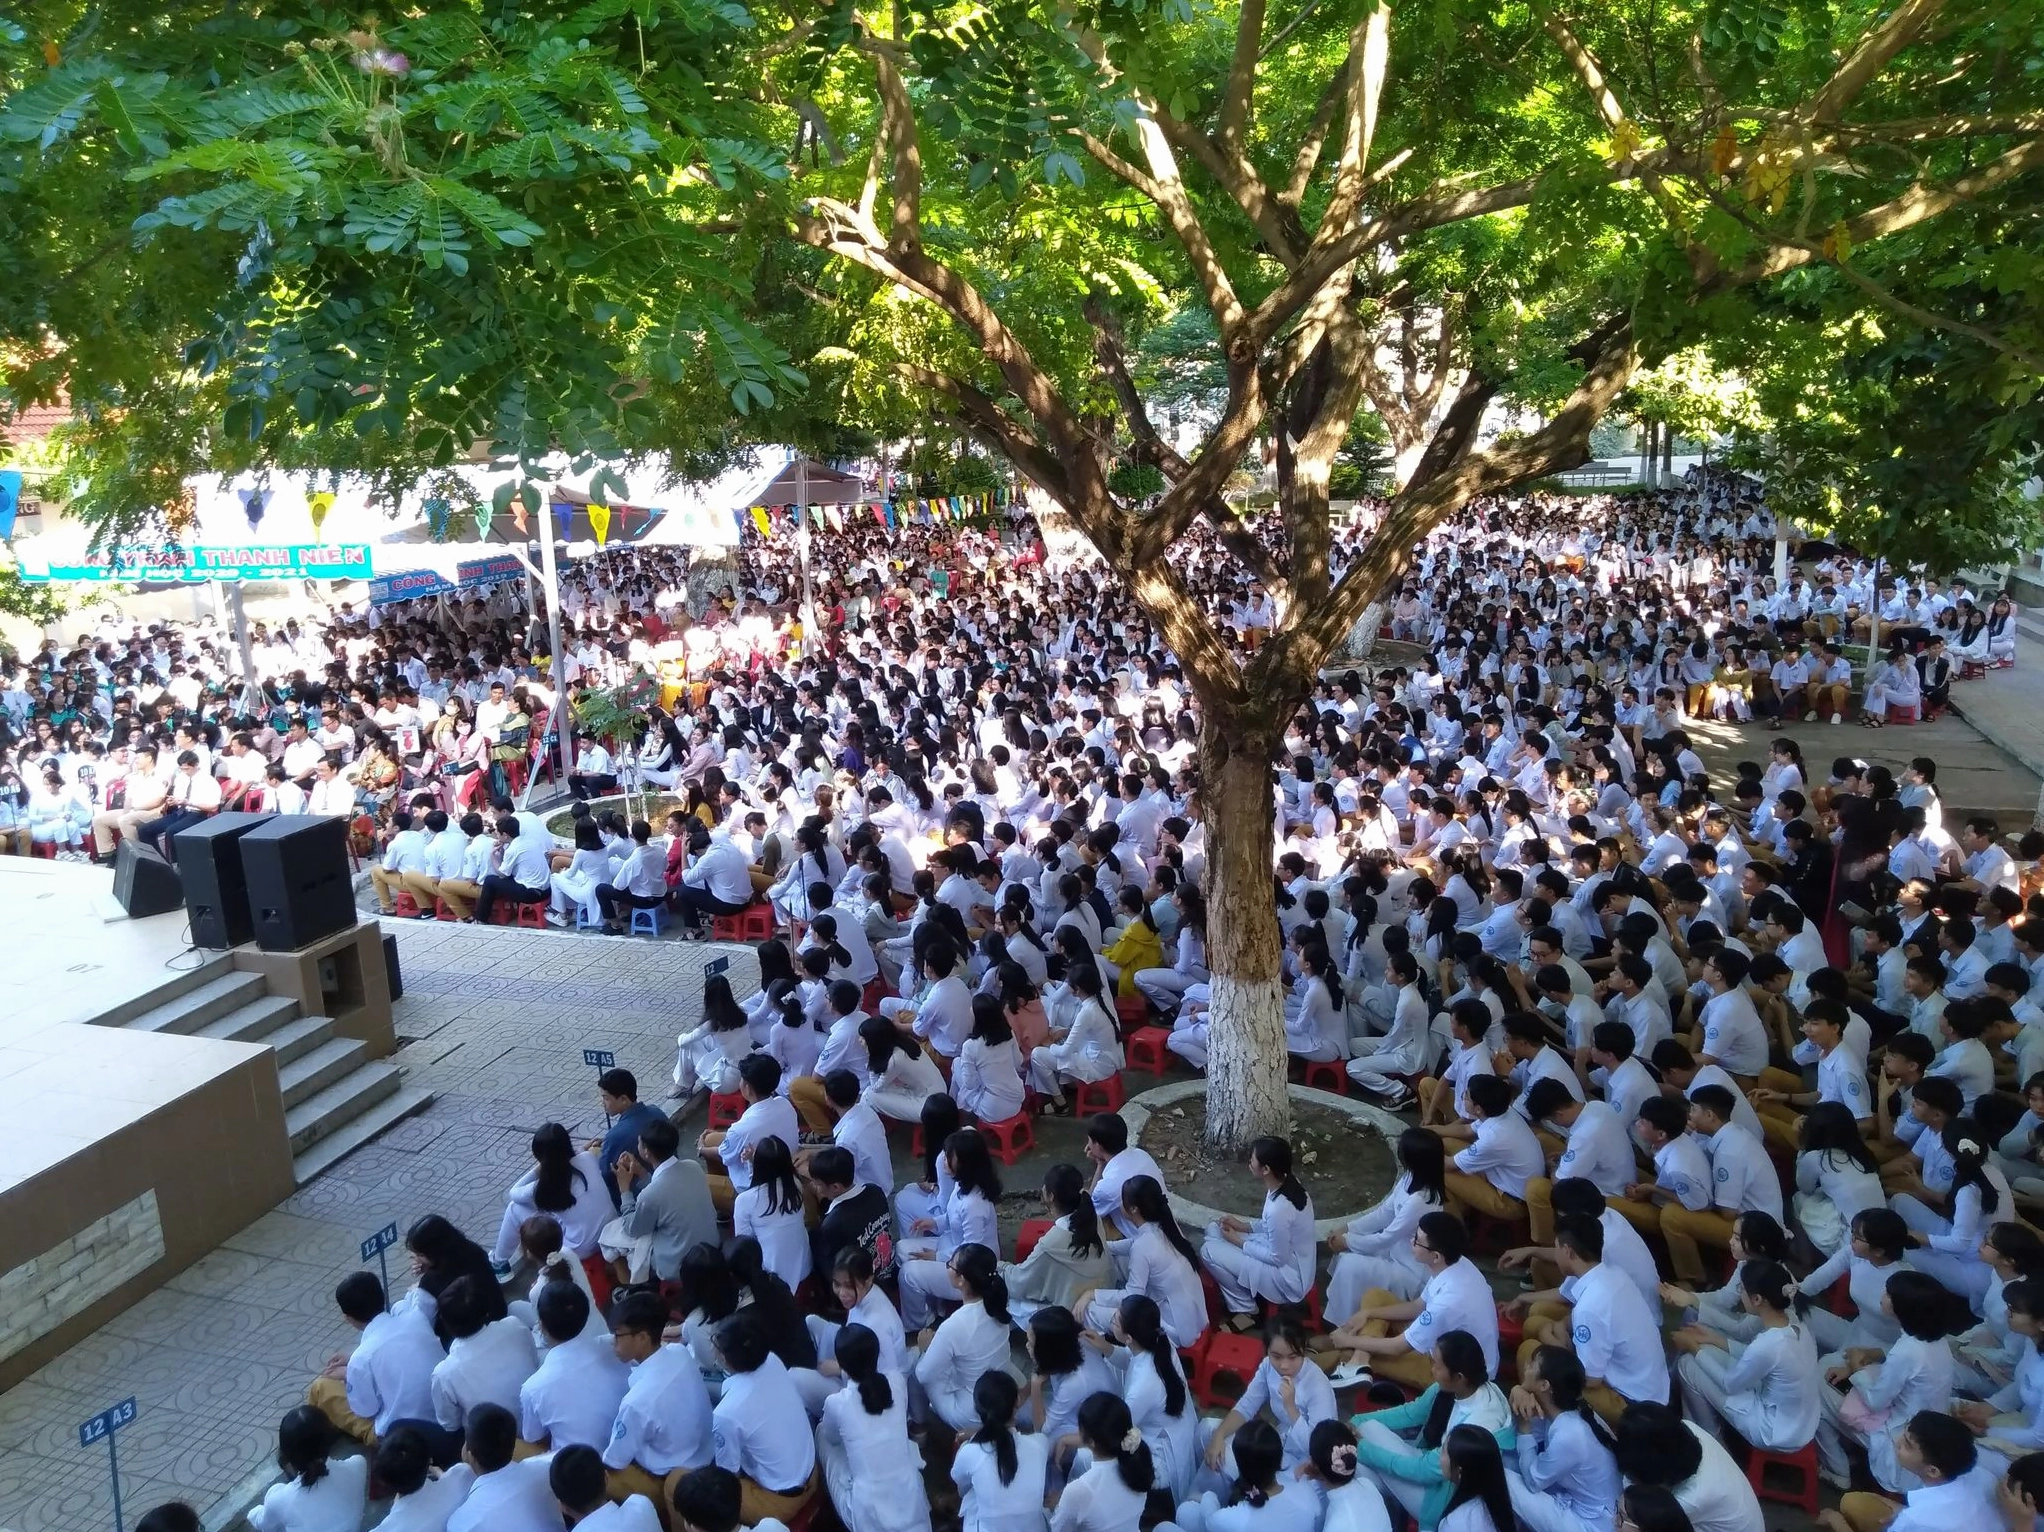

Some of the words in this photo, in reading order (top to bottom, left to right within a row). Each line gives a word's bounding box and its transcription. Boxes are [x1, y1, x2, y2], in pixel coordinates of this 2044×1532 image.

[204, 549, 290, 566] THANH
[392, 574, 436, 591] CÔNG
[585, 1052, 598, 1064] 12
[600, 1053, 613, 1065] A5
[365, 1238, 378, 1257] 12
[84, 1418, 105, 1441] 12
[112, 1402, 133, 1426] A3
